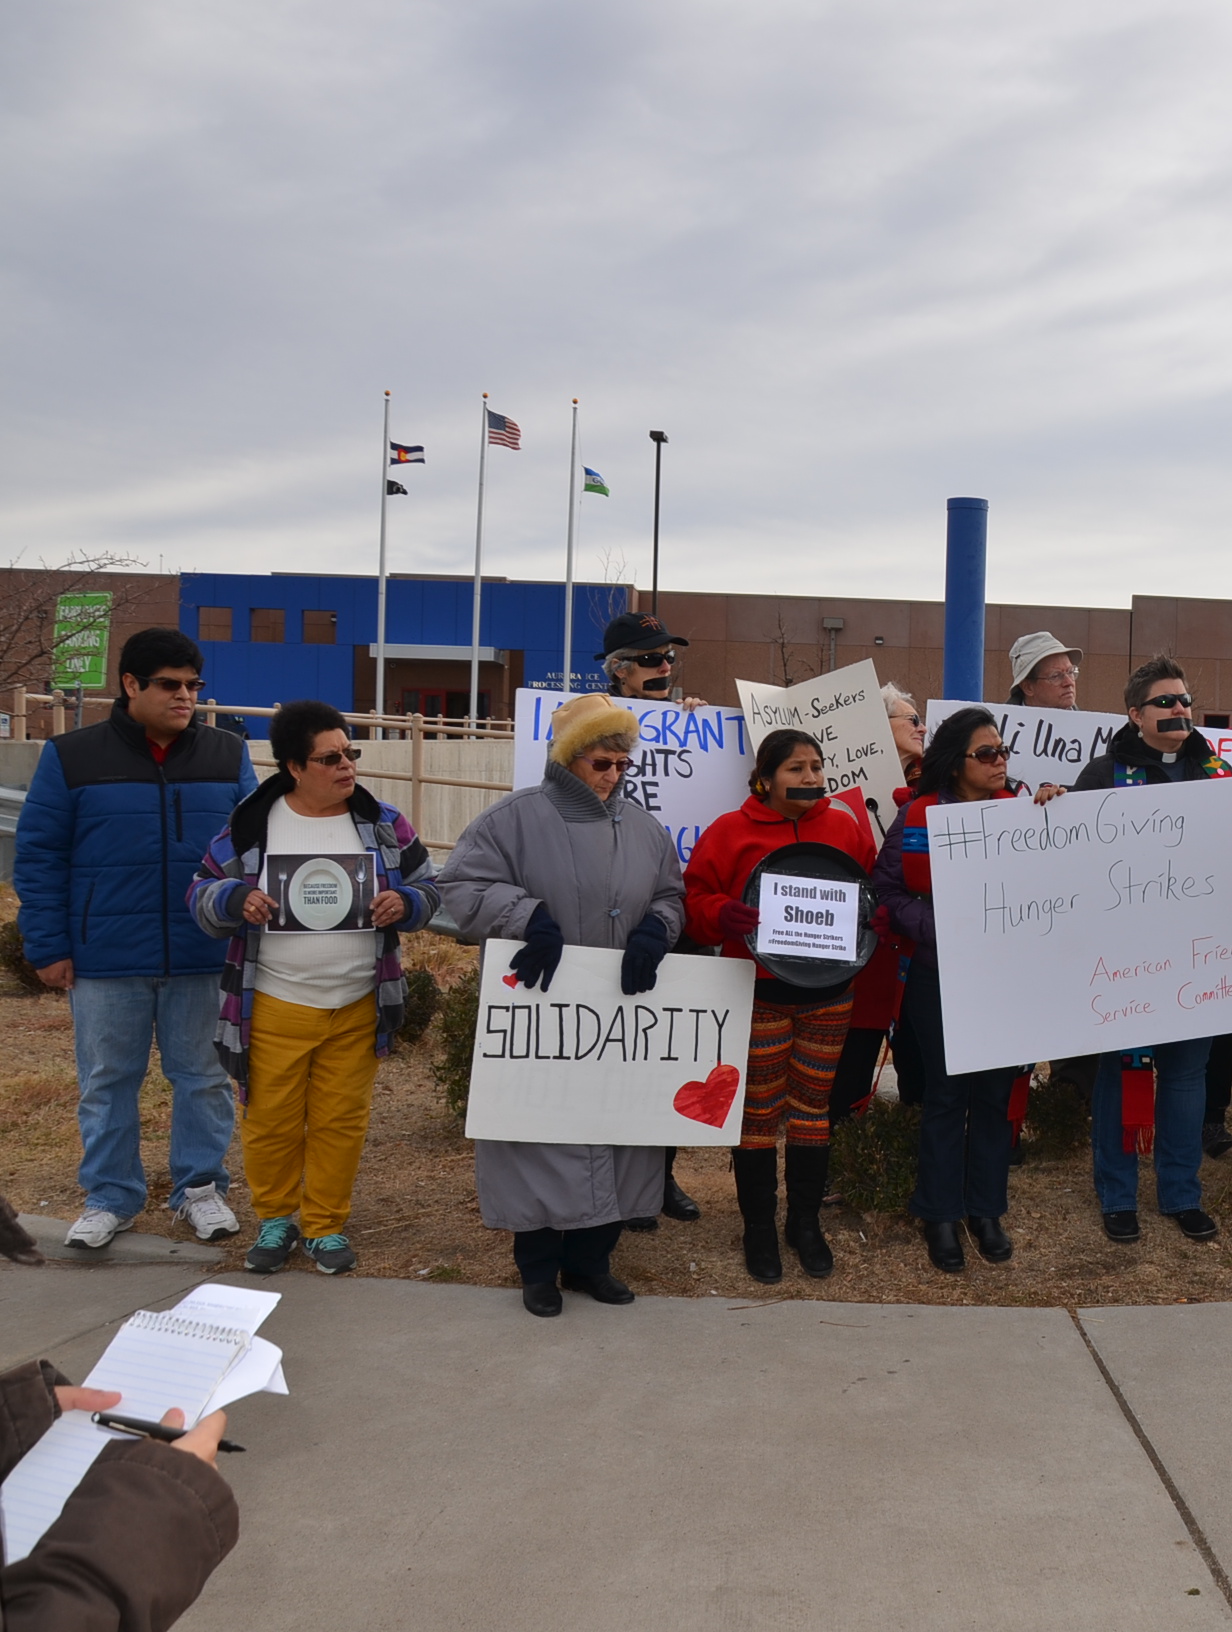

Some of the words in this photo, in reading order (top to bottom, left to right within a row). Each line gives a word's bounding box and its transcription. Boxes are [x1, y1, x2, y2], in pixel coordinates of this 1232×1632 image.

[528, 681, 581, 689] PROCESSNG
[546, 672, 582, 680] AURRA
[533, 696, 745, 756] IGRANT
[846, 742, 884, 763] LOVE,
[1033, 719, 1082, 763] Una
[622, 780, 662, 811] RE
[303, 896, 320, 904] THAN
[321, 896, 338, 904] FOOD
[774, 882, 778, 895] I
[781, 885, 816, 899] stand
[820, 888, 846, 902] with
[984, 881, 1080, 936] Hunger
[1104, 859, 1214, 912] Strikes
[784, 905, 834, 927] Shoeb
[1090, 957, 1171, 986] American
[1091, 994, 1155, 1026] Service
[483, 1003, 730, 1062] SOLIDARITY
